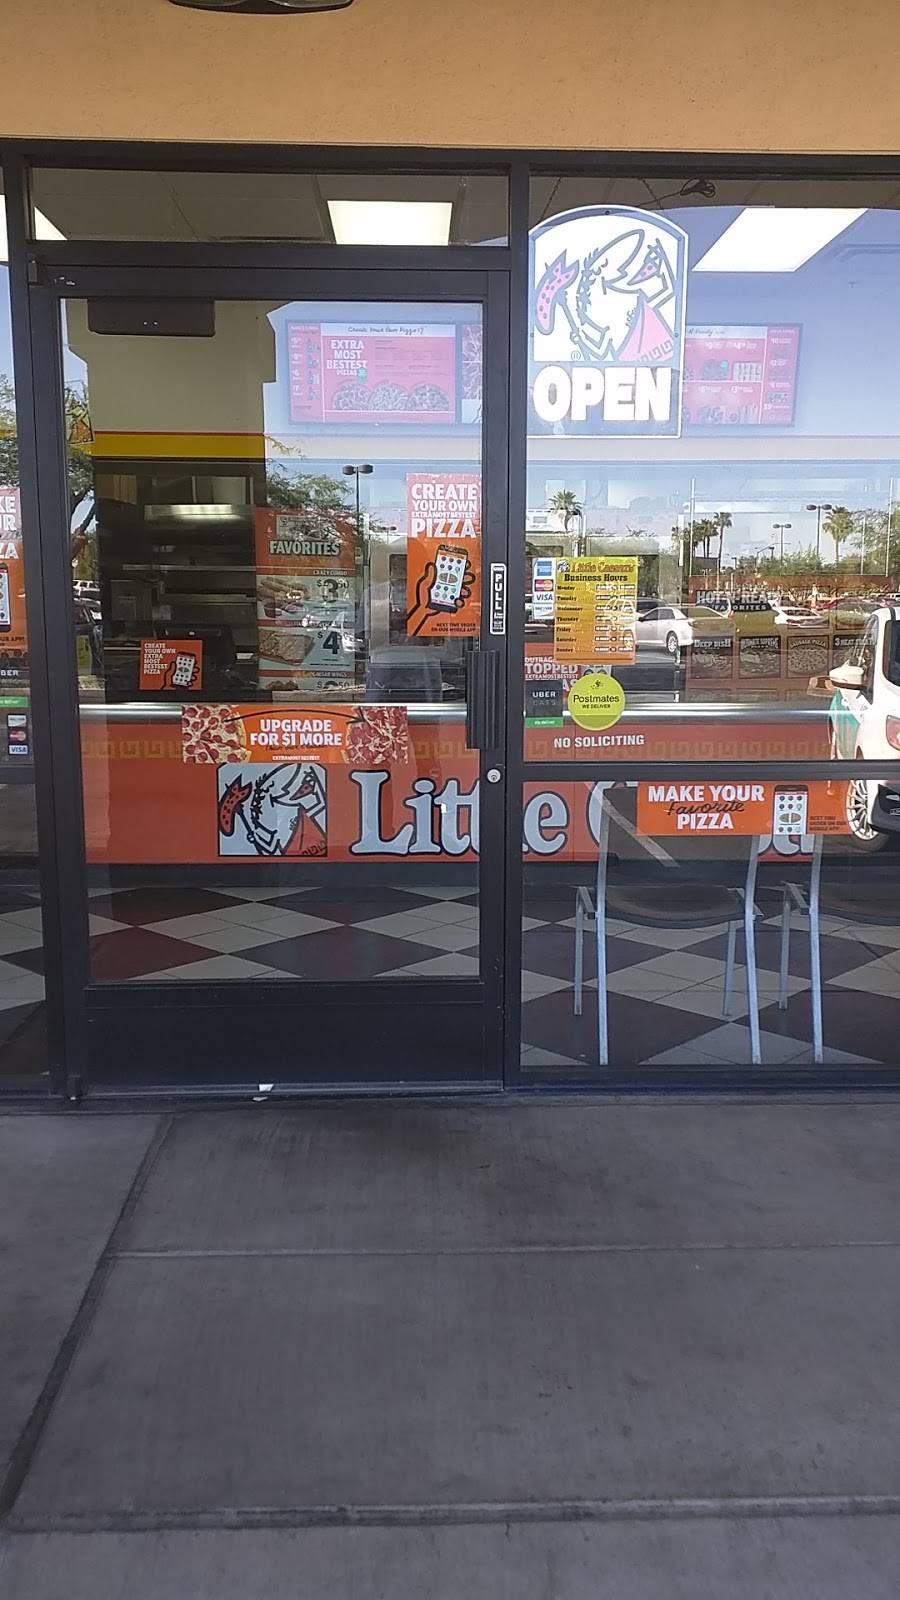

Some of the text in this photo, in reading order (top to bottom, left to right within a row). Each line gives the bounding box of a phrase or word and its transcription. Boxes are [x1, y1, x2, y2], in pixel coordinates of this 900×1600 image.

[331, 340, 364, 349] EXTRA
[334, 350, 362, 359] MOST
[326, 360, 367, 369] BESTEST
[533, 366, 671, 422] OPEN
[411, 483, 478, 500] CREATE
[412, 501, 477, 511] YOUR OWN
[411, 518, 477, 538] PIZZA
[269, 540, 341, 556] FAVORITES
[564, 574, 628, 582] Business Hours
[495, 573, 503, 610] PULL
[525, 663, 578, 674] TOPPED
[573, 694, 620, 703] Postmates
[260, 719, 332, 732] UPGRADE
[250, 732, 342, 747] FOR $1 MORE
[554, 735, 645, 748] NO SOLICITING
[11, 745, 27, 755] VISA
[648, 785, 765, 802] MAKE YOUR
[350, 769, 568, 856] Litte
[667, 800, 745, 816] Favorite
[676, 813, 734, 830] PIZZA
